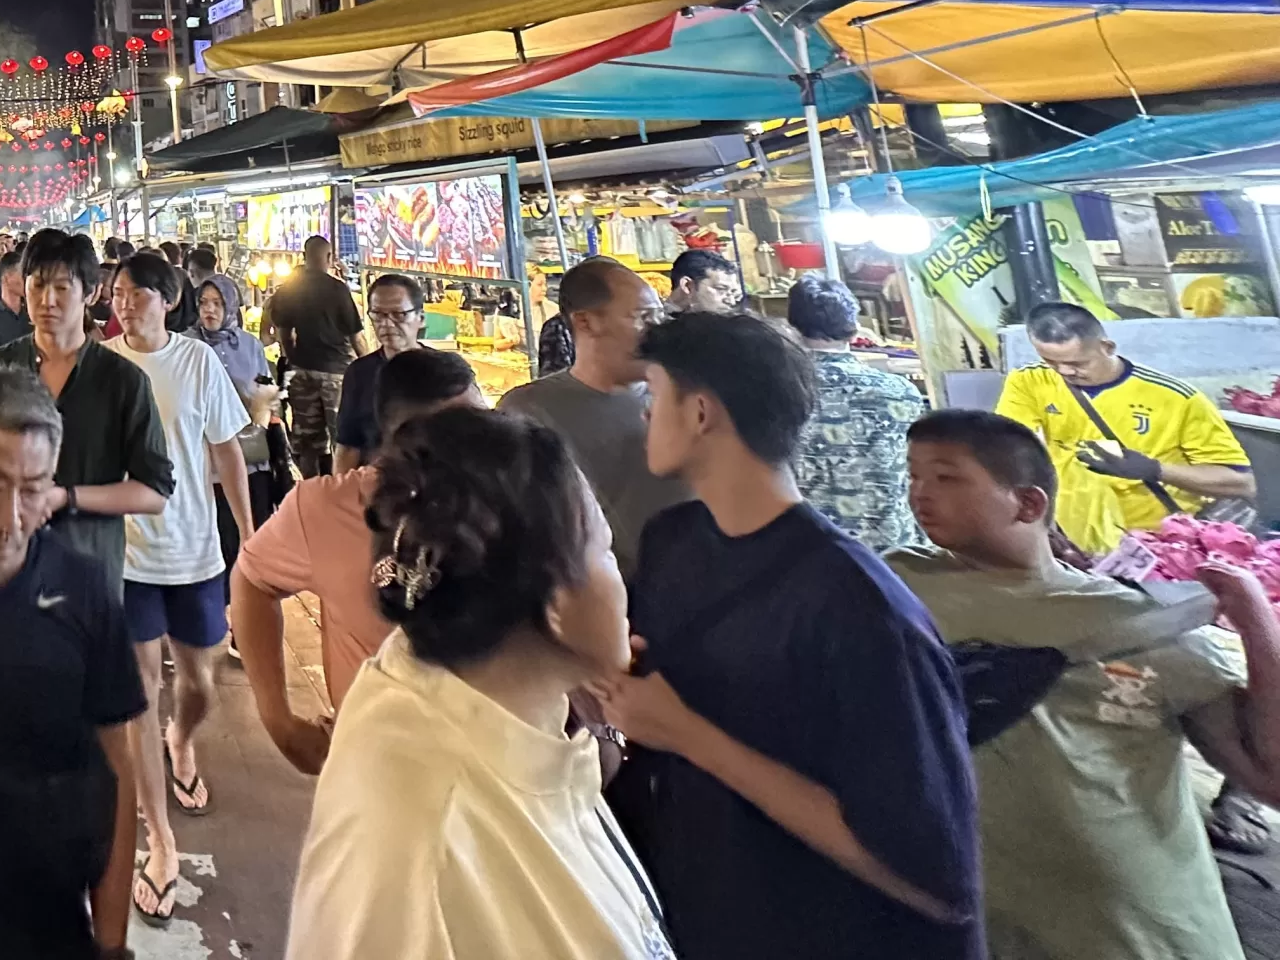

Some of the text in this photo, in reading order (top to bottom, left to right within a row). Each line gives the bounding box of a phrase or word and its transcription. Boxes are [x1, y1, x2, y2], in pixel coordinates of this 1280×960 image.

[458, 118, 525, 142] Sizzling squid
[923, 213, 1006, 280] MUSANG
[954, 240, 1008, 288] KING
